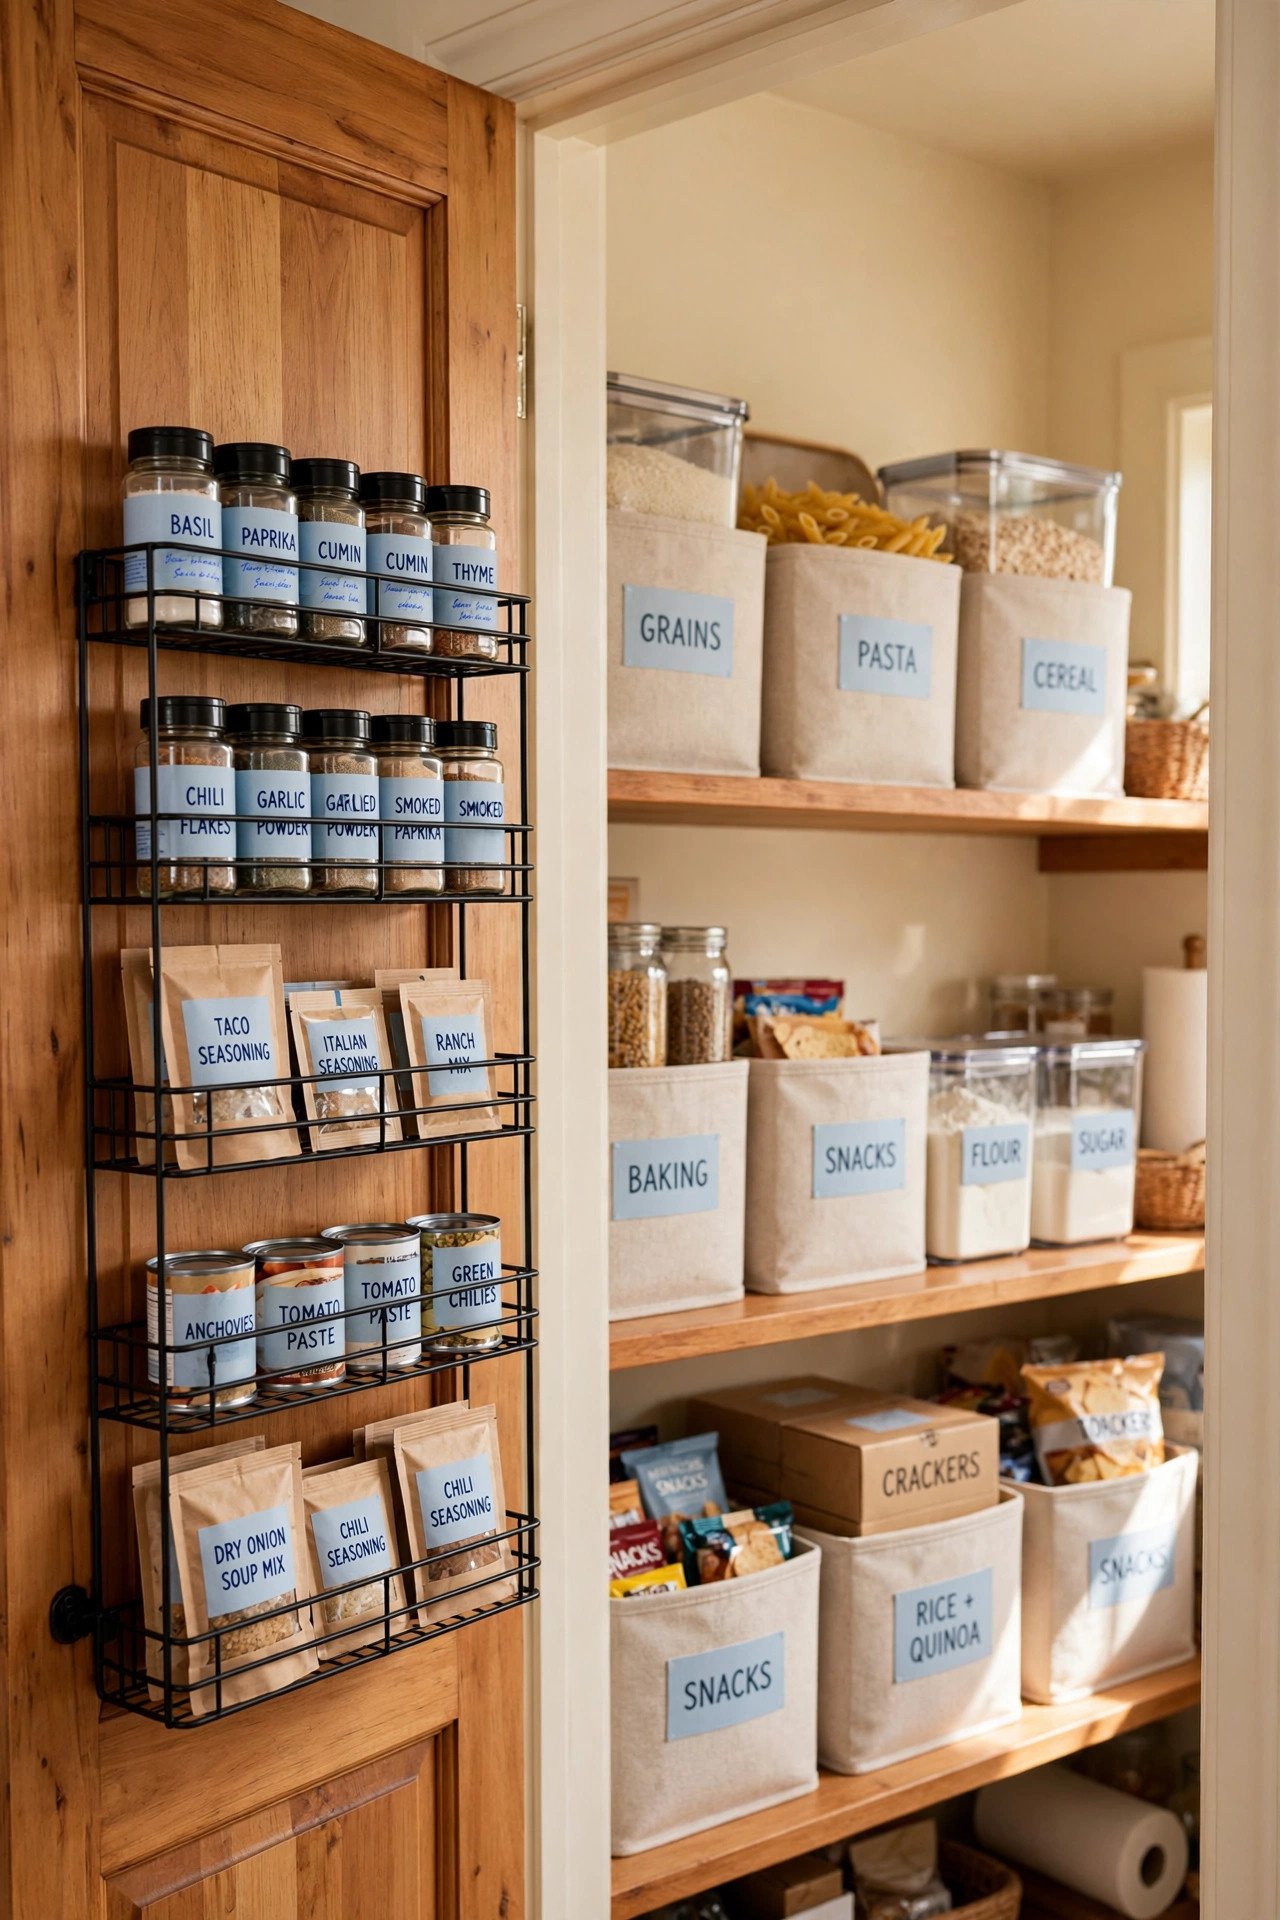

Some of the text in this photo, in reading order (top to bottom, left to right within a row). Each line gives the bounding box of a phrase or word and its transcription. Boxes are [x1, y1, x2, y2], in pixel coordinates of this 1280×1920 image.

[170, 514, 214, 539] BASIL
[241, 527, 297, 552] PAPRIKA
[318, 541, 361, 563] CUMIN
[386, 552, 428, 574] CUMIN
[452, 562, 494, 584] THYME
[640, 612, 721, 651] GRAINS
[857, 639, 917, 674] PASTA
[1033, 661, 1098, 694] CEREAL
[186, 786, 224, 806] CHILI
[257, 790, 305, 809] GARLIC
[395, 796, 441, 815] SMOKED
[180, 817, 231, 835] FLAKES
[257, 821, 308, 836] POWDER
[327, 823, 377, 838] POWDER
[395, 824, 441, 840] PAPRIKA
[214, 1016, 250, 1036] TACO
[198, 1041, 271, 1066] SEASONING
[323, 1034, 368, 1053] ITALIAN
[435, 1032, 475, 1051] RANCH
[318, 1055, 378, 1076] SEASONING
[448, 1056, 472, 1075] MIX
[971, 1138, 1022, 1167] FLOUR
[1078, 1127, 1127, 1154] SUGAR
[825, 1141, 897, 1175] SNACKS
[628, 1158, 708, 1195] BAKING
[452, 1261, 494, 1283] GREEN
[361, 1276, 416, 1299] TOMATO
[449, 1286, 496, 1308] CHILIES
[279, 1299, 340, 1324] TOMATO
[185, 1314, 254, 1340] ANCHOVIES
[287, 1326, 336, 1350] PASTE
[882, 1451, 980, 1497] CRACKERS
[443, 1475, 474, 1498] CHILI
[430, 1495, 492, 1528] SEASONING
[340, 1516, 370, 1539] CHILI
[213, 1526, 287, 1565] DRY ONION
[327, 1535, 387, 1568] SEASONING
[221, 1554, 286, 1591] SOUP MIX
[915, 1593, 976, 1626] RICE +
[909, 1621, 982, 1663] QUINOA
[682, 1658, 773, 1711] SNACKS
